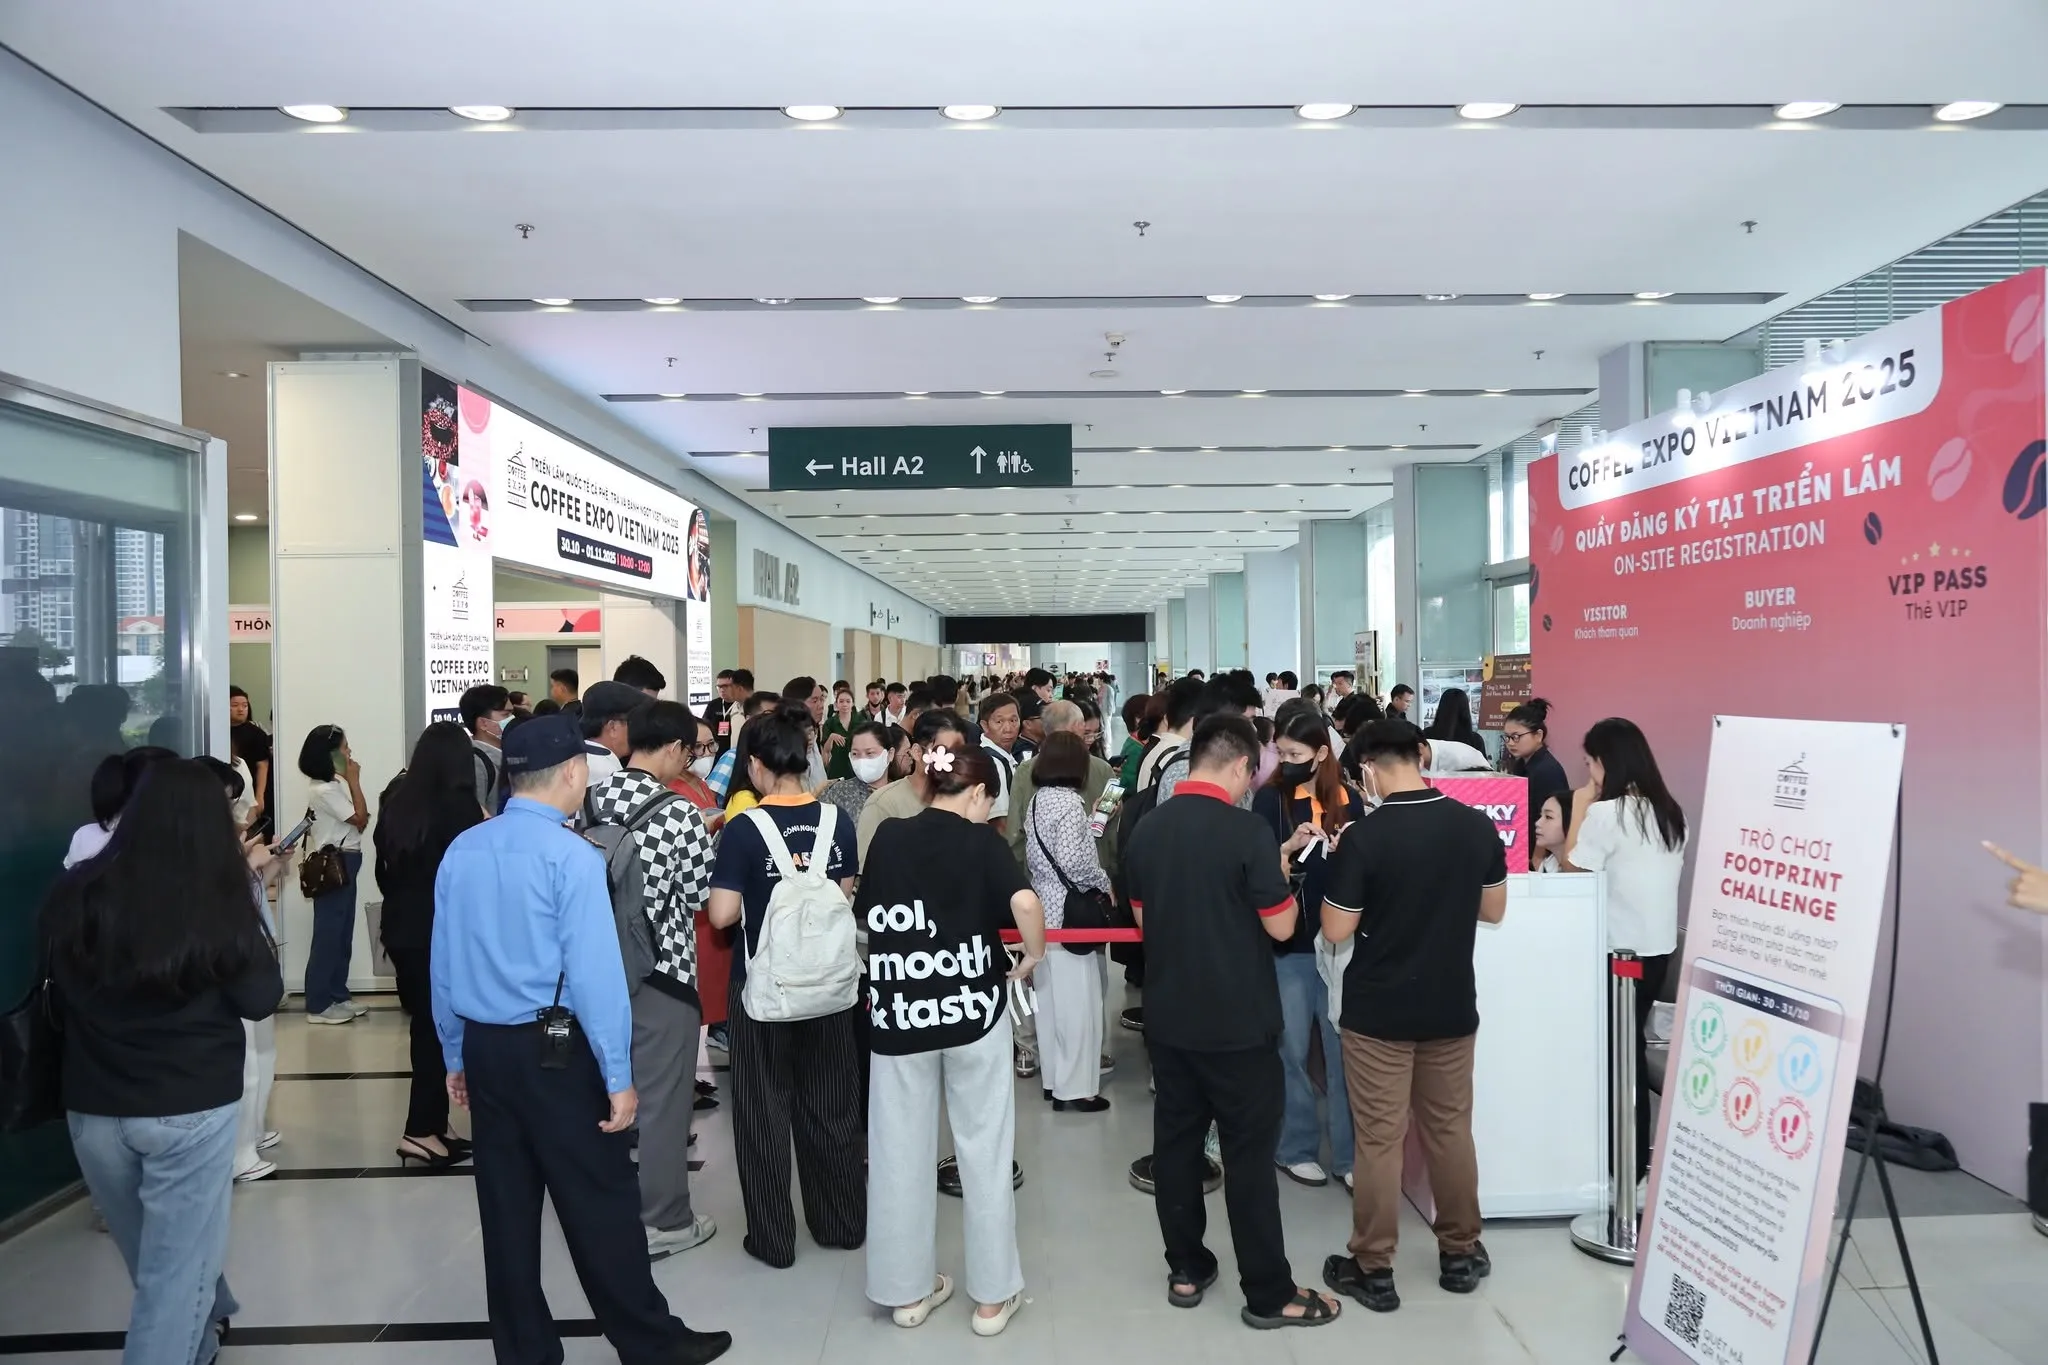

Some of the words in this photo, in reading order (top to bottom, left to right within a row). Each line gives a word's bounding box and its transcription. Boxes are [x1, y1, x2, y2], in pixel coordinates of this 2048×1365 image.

[1642, 426, 1696, 470] EXPO
[1706, 380, 1827, 449] VIETNAM
[1841, 349, 1916, 408] 2025
[841, 456, 885, 476] Hall
[892, 455, 924, 475] A2
[1576, 515, 1615, 552] QUẦY
[1620, 511, 1668, 543] ĐĂNG
[1674, 496, 1700, 532] KÝ
[1707, 493, 1744, 529] TẠI
[1752, 461, 1832, 515] TRIỂN
[1843, 453, 1902, 497] LÃM
[530, 481, 581, 522] COFFEE
[585, 501, 614, 534] EXPO
[617, 513, 660, 549] VIETNAM
[661, 531, 680, 555] 2025
[560, 537, 580, 555] 30.10
[1614, 547, 1675, 575] ON-SITE
[1680, 519, 1825, 567] REGISTRATION
[1887, 573, 1925, 595] VIP
[1933, 565, 1988, 592] PASS
[1745, 586, 1796, 608] BUYER
[1905, 600, 1933, 620] Thẻ
[1937, 599, 1968, 618] VIP
[1583, 604, 1628, 622] VISITOR
[1732, 613, 1767, 631] Doanh
[1770, 610, 1812, 632] nghiệp
[430, 659, 465, 675] COFFEE
[467, 660, 489, 674] EXPO
[430, 679, 470, 694] VIETNAM
[1740, 827, 1776, 851] TRÒ
[1780, 835, 1833, 862] CHƠI
[1723, 851, 1844, 893] FOOTPRINT
[1720, 877, 1838, 922] CHALLENGE
[869, 934, 992, 981] mooth
[892, 984, 1000, 1031] tasty
[1761, 996, 1775, 1009] 30
[1781, 1002, 1810, 1021] 31/10
